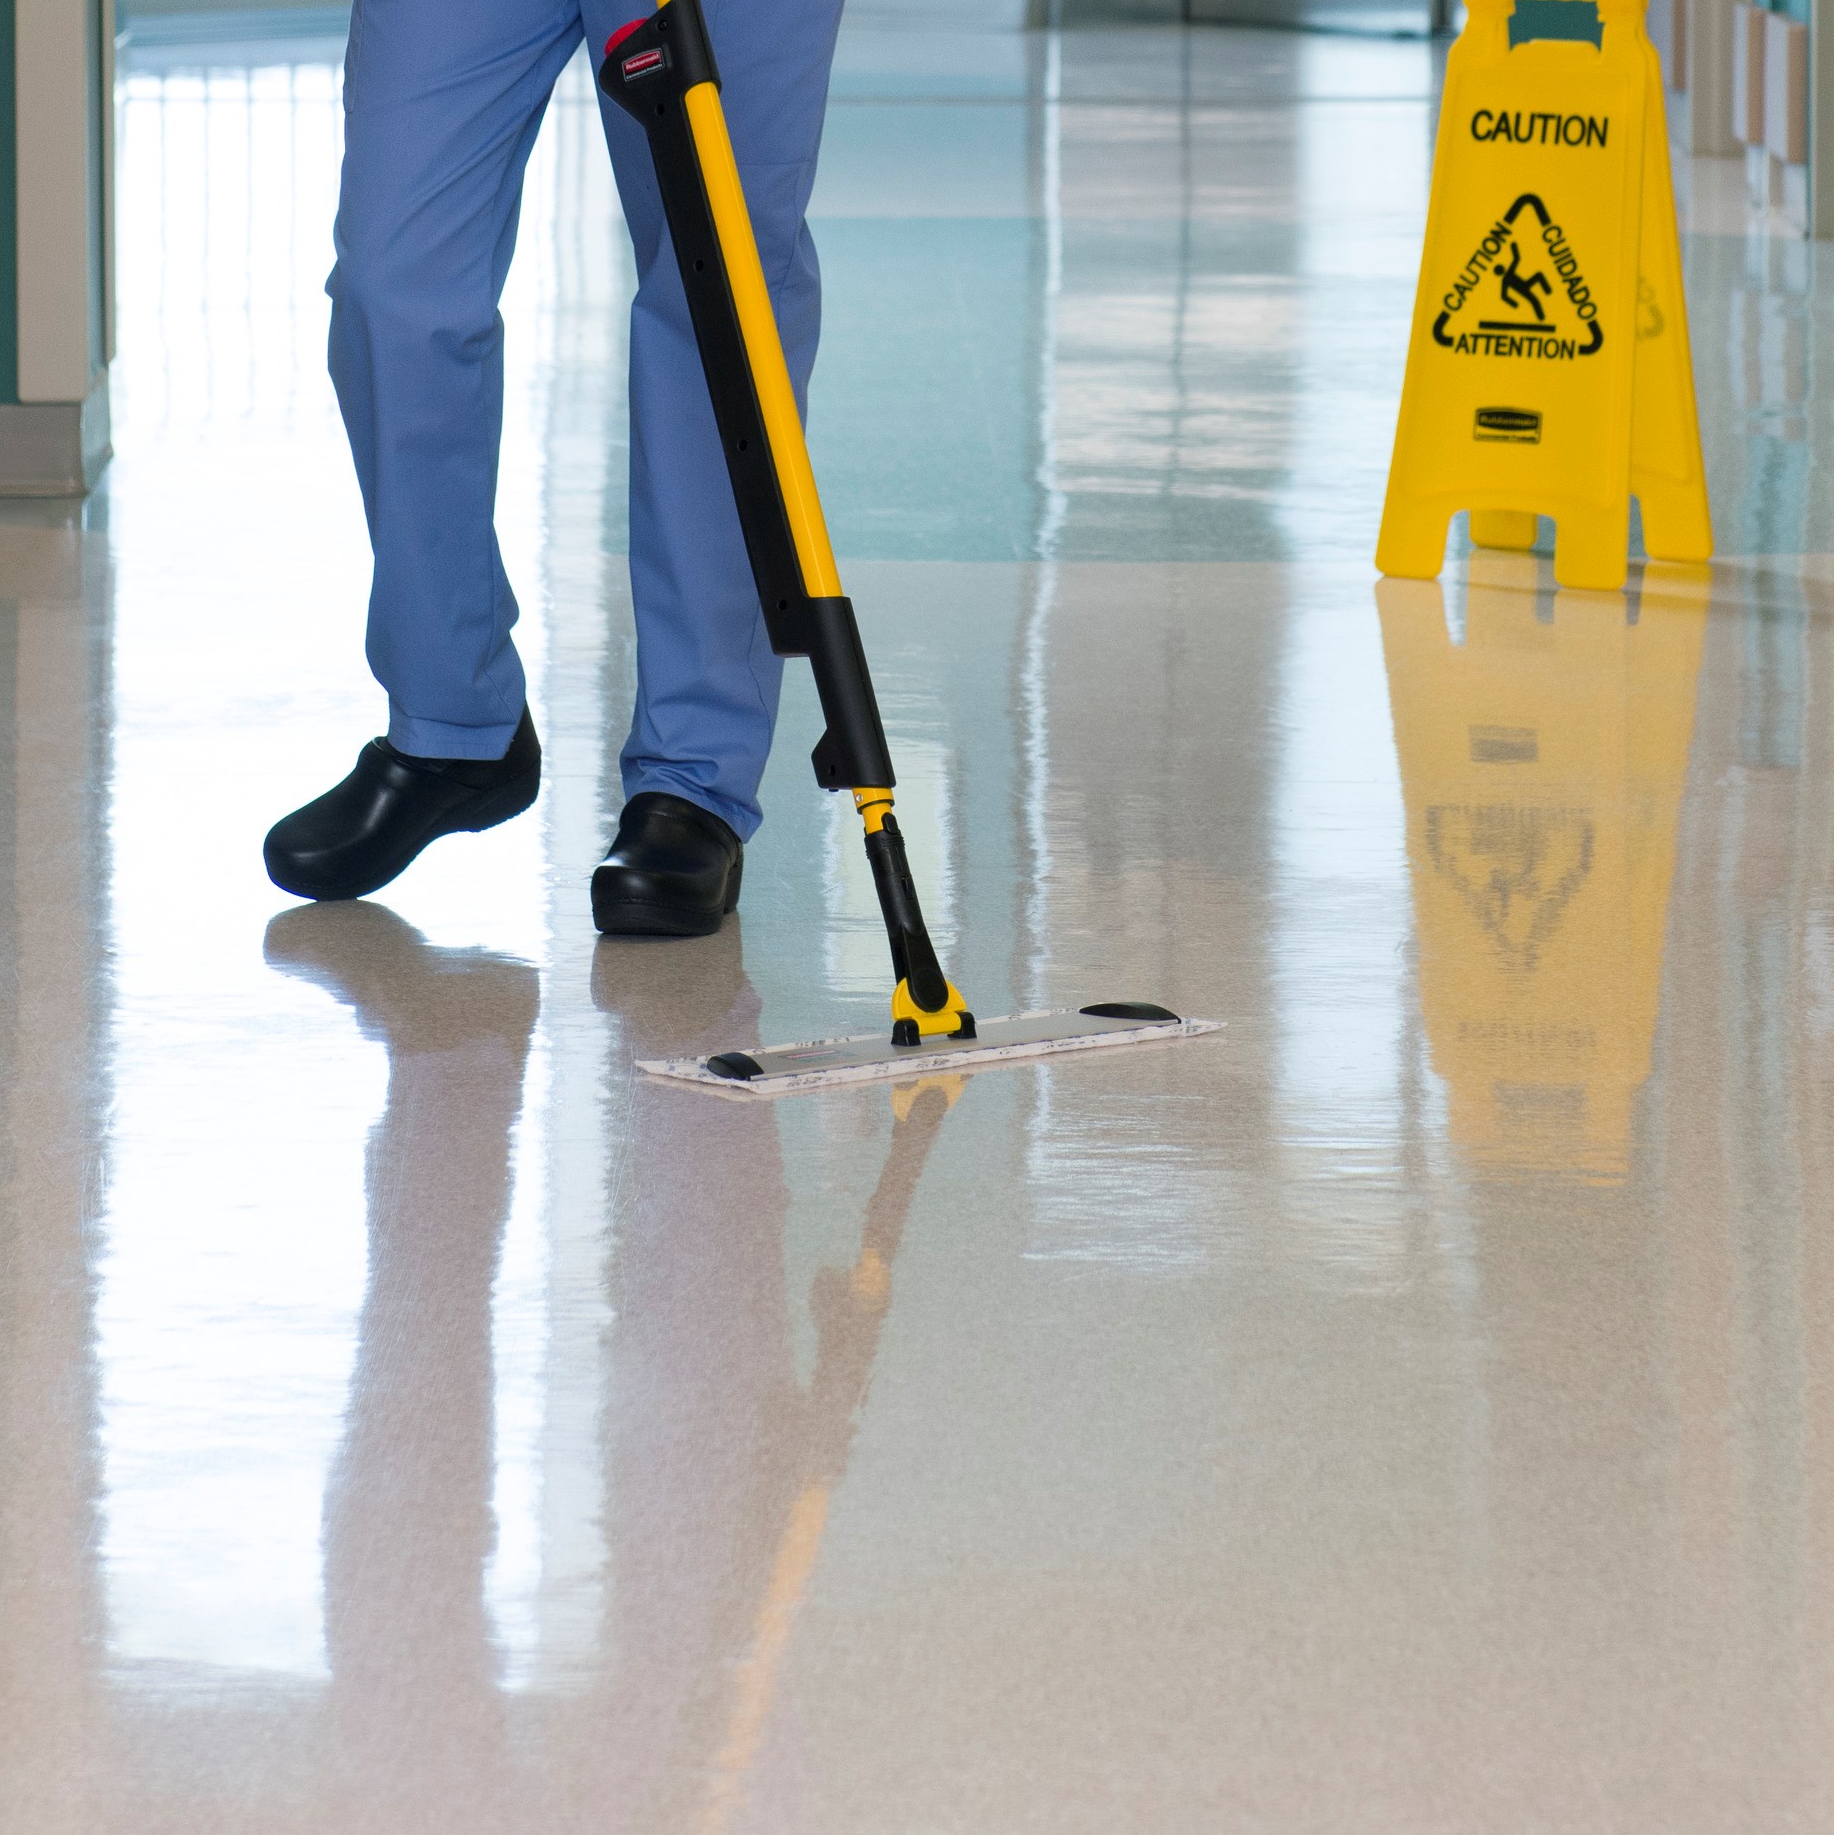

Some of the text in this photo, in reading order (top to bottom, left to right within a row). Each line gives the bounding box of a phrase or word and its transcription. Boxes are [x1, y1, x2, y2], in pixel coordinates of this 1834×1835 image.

[1470, 109, 1609, 148] CAUTION
[1443, 222, 1512, 313] CAUTION
[1541, 225, 1597, 321] CUIDADO
[1454, 333, 1576, 359] ATTENTION
